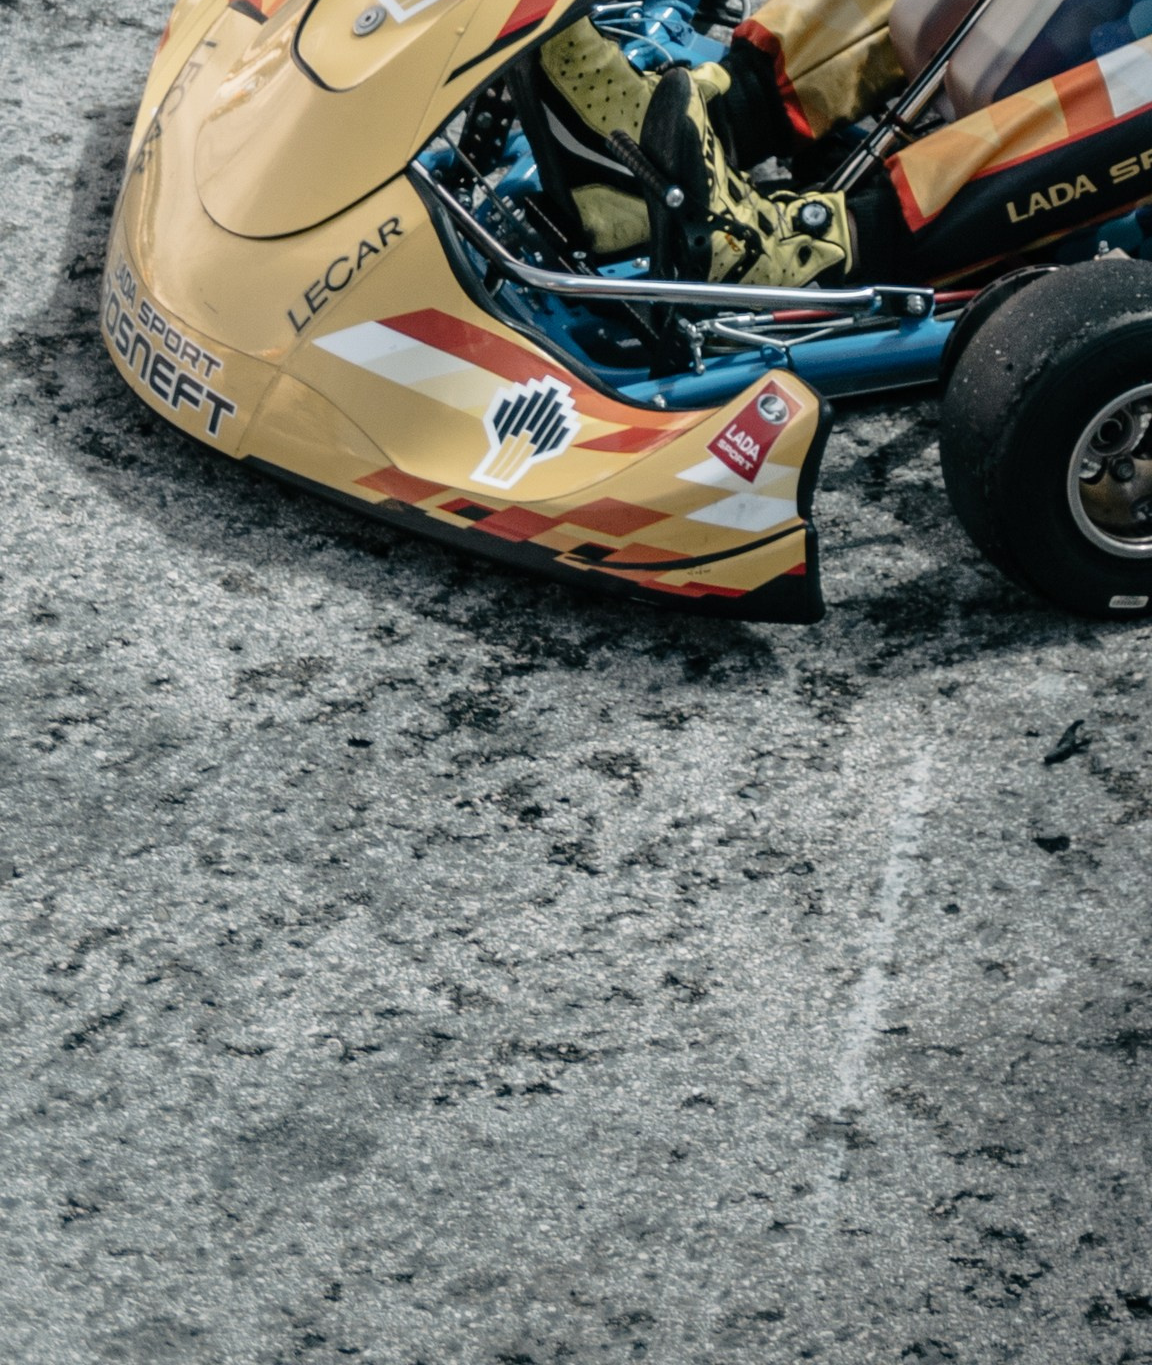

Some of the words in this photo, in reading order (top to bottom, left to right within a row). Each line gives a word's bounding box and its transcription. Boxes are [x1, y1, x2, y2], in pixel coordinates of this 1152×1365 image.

[1005, 173, 1099, 225] LADA
[286, 215, 404, 334] LECAR
[137, 298, 222, 379] SPORT
[716, 438, 755, 472] SPORT
[724, 423, 761, 462] LADA
